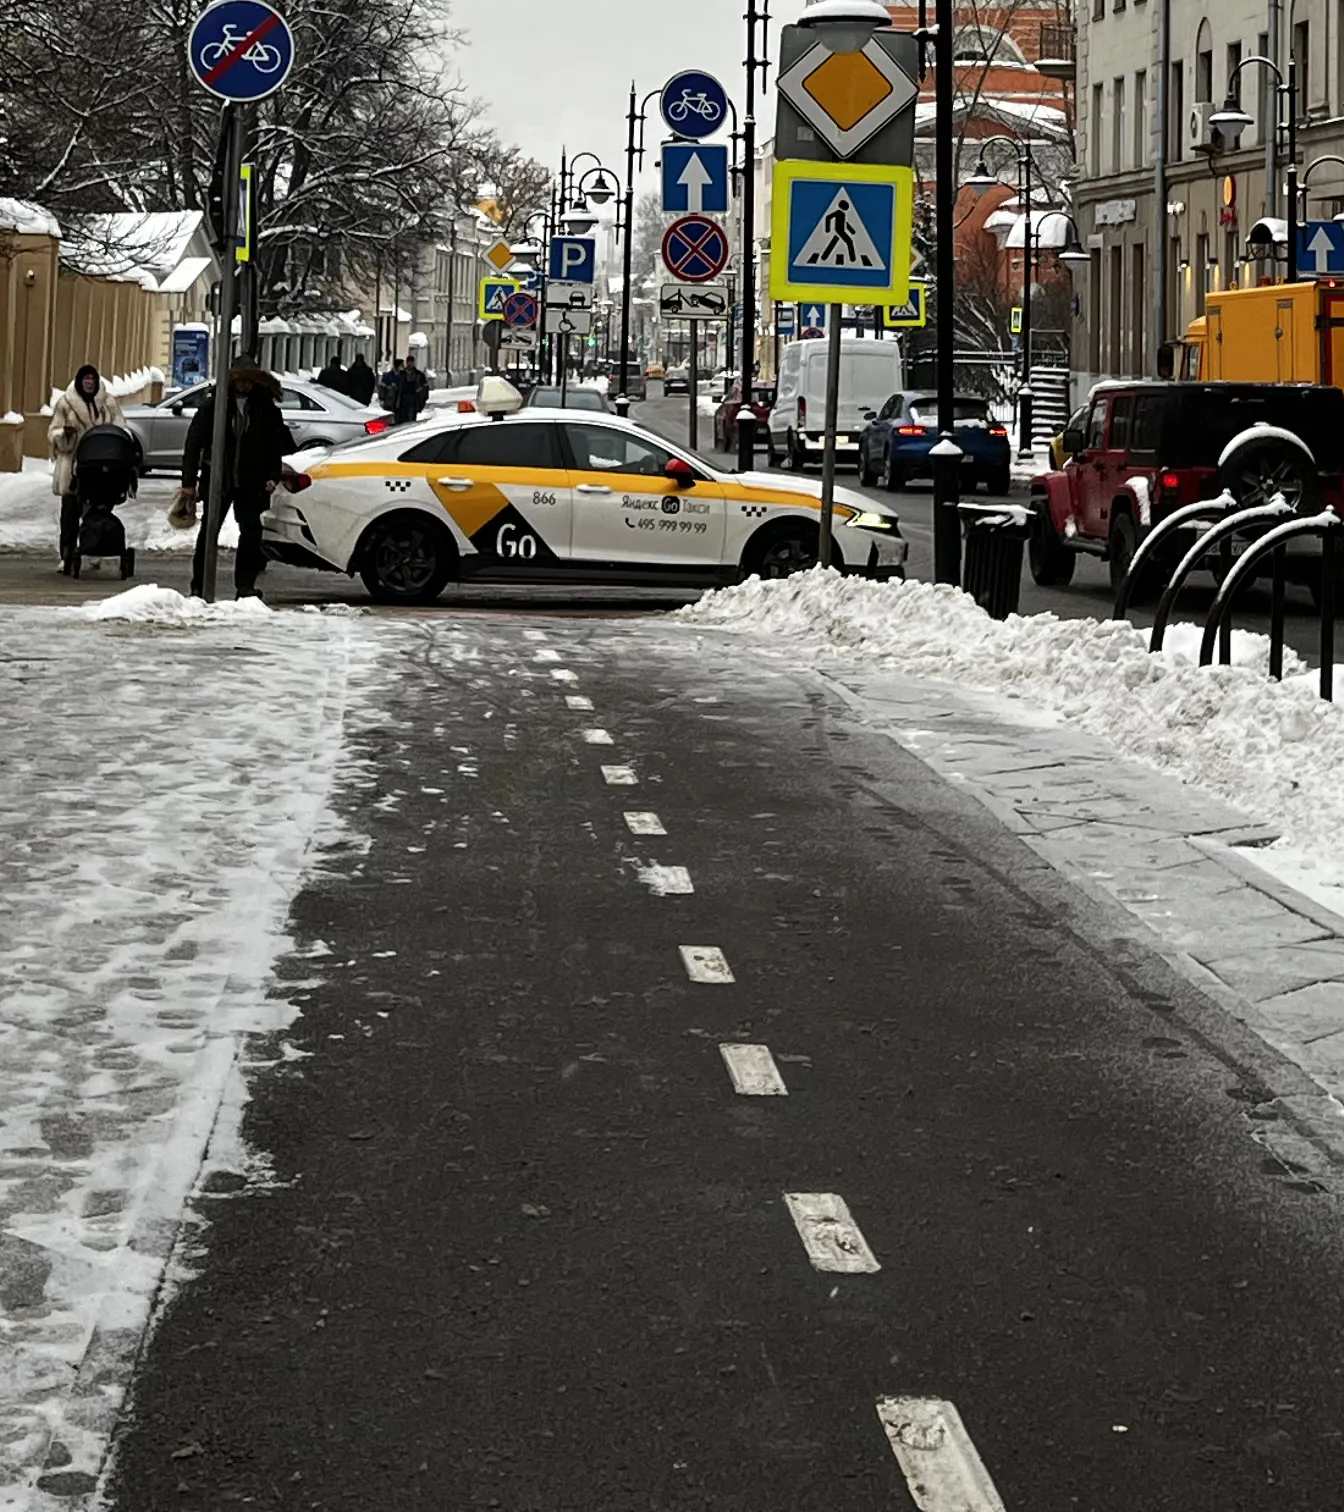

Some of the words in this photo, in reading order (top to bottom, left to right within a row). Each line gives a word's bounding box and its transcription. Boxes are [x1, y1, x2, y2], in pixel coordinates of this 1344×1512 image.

[561, 243, 586, 278] P
[532, 491, 557, 506] 866
[621, 495, 658, 510] Яндекс
[658, 519, 677, 532] 999
[679, 520, 692, 533] 99
[694, 521, 707, 534] 99
[496, 523, 537, 559] Go
